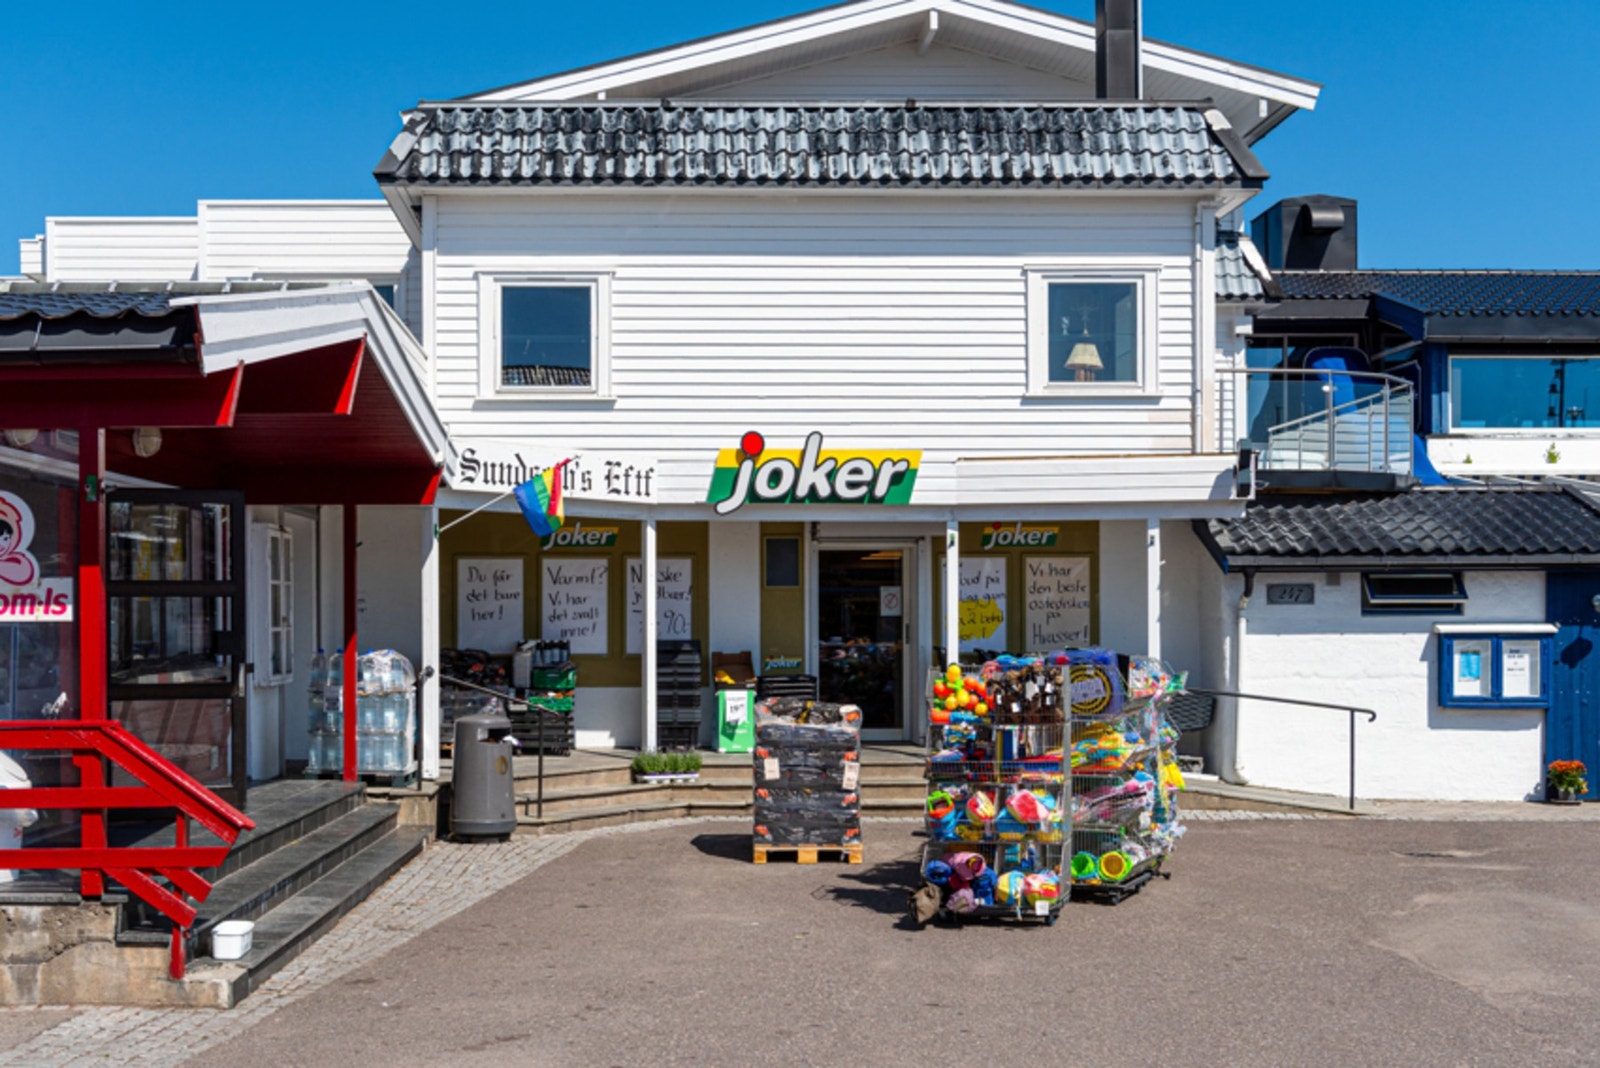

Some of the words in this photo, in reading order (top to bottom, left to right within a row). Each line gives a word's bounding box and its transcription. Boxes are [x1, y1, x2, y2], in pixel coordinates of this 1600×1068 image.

[714, 431, 910, 516] joker
[542, 521, 613, 551] joker
[983, 521, 1054, 551] joker
[1279, 587, 1304, 602] 247
